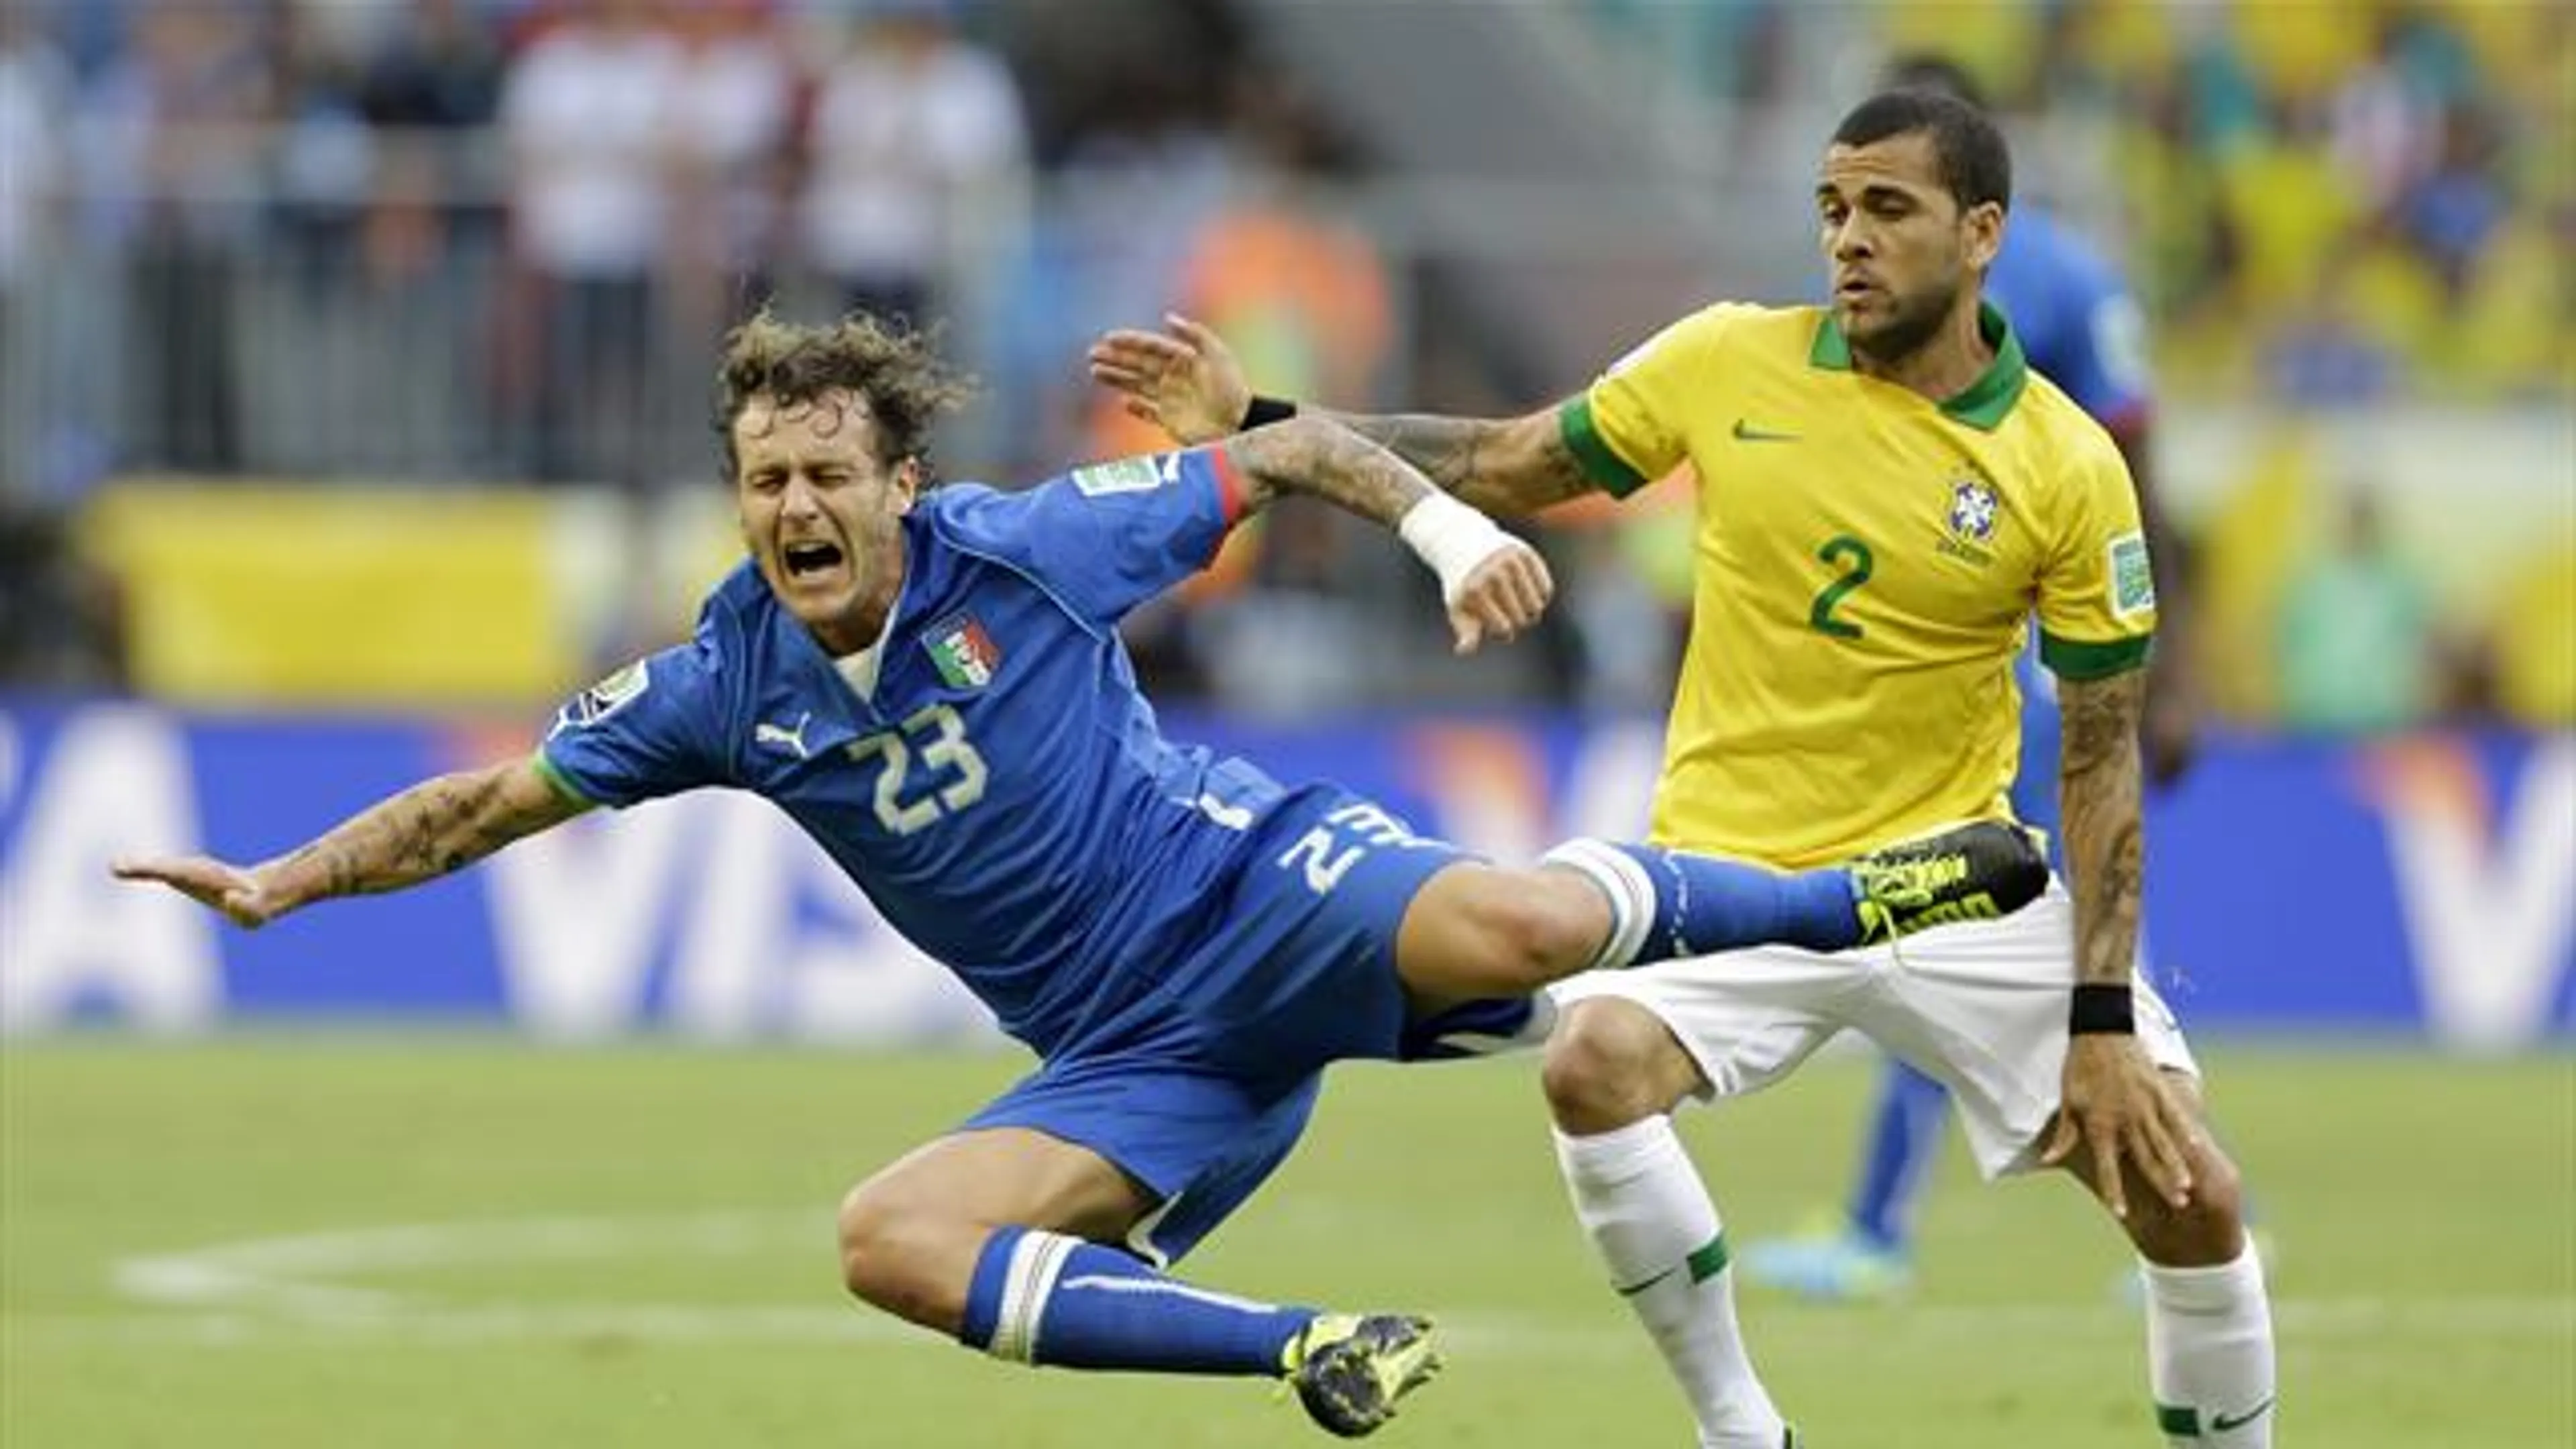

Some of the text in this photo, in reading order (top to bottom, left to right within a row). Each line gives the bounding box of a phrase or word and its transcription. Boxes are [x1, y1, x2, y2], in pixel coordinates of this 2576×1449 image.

[1809, 535, 1874, 639] 2
[845, 704, 988, 837] 23
[1277, 804, 1415, 895] 23
